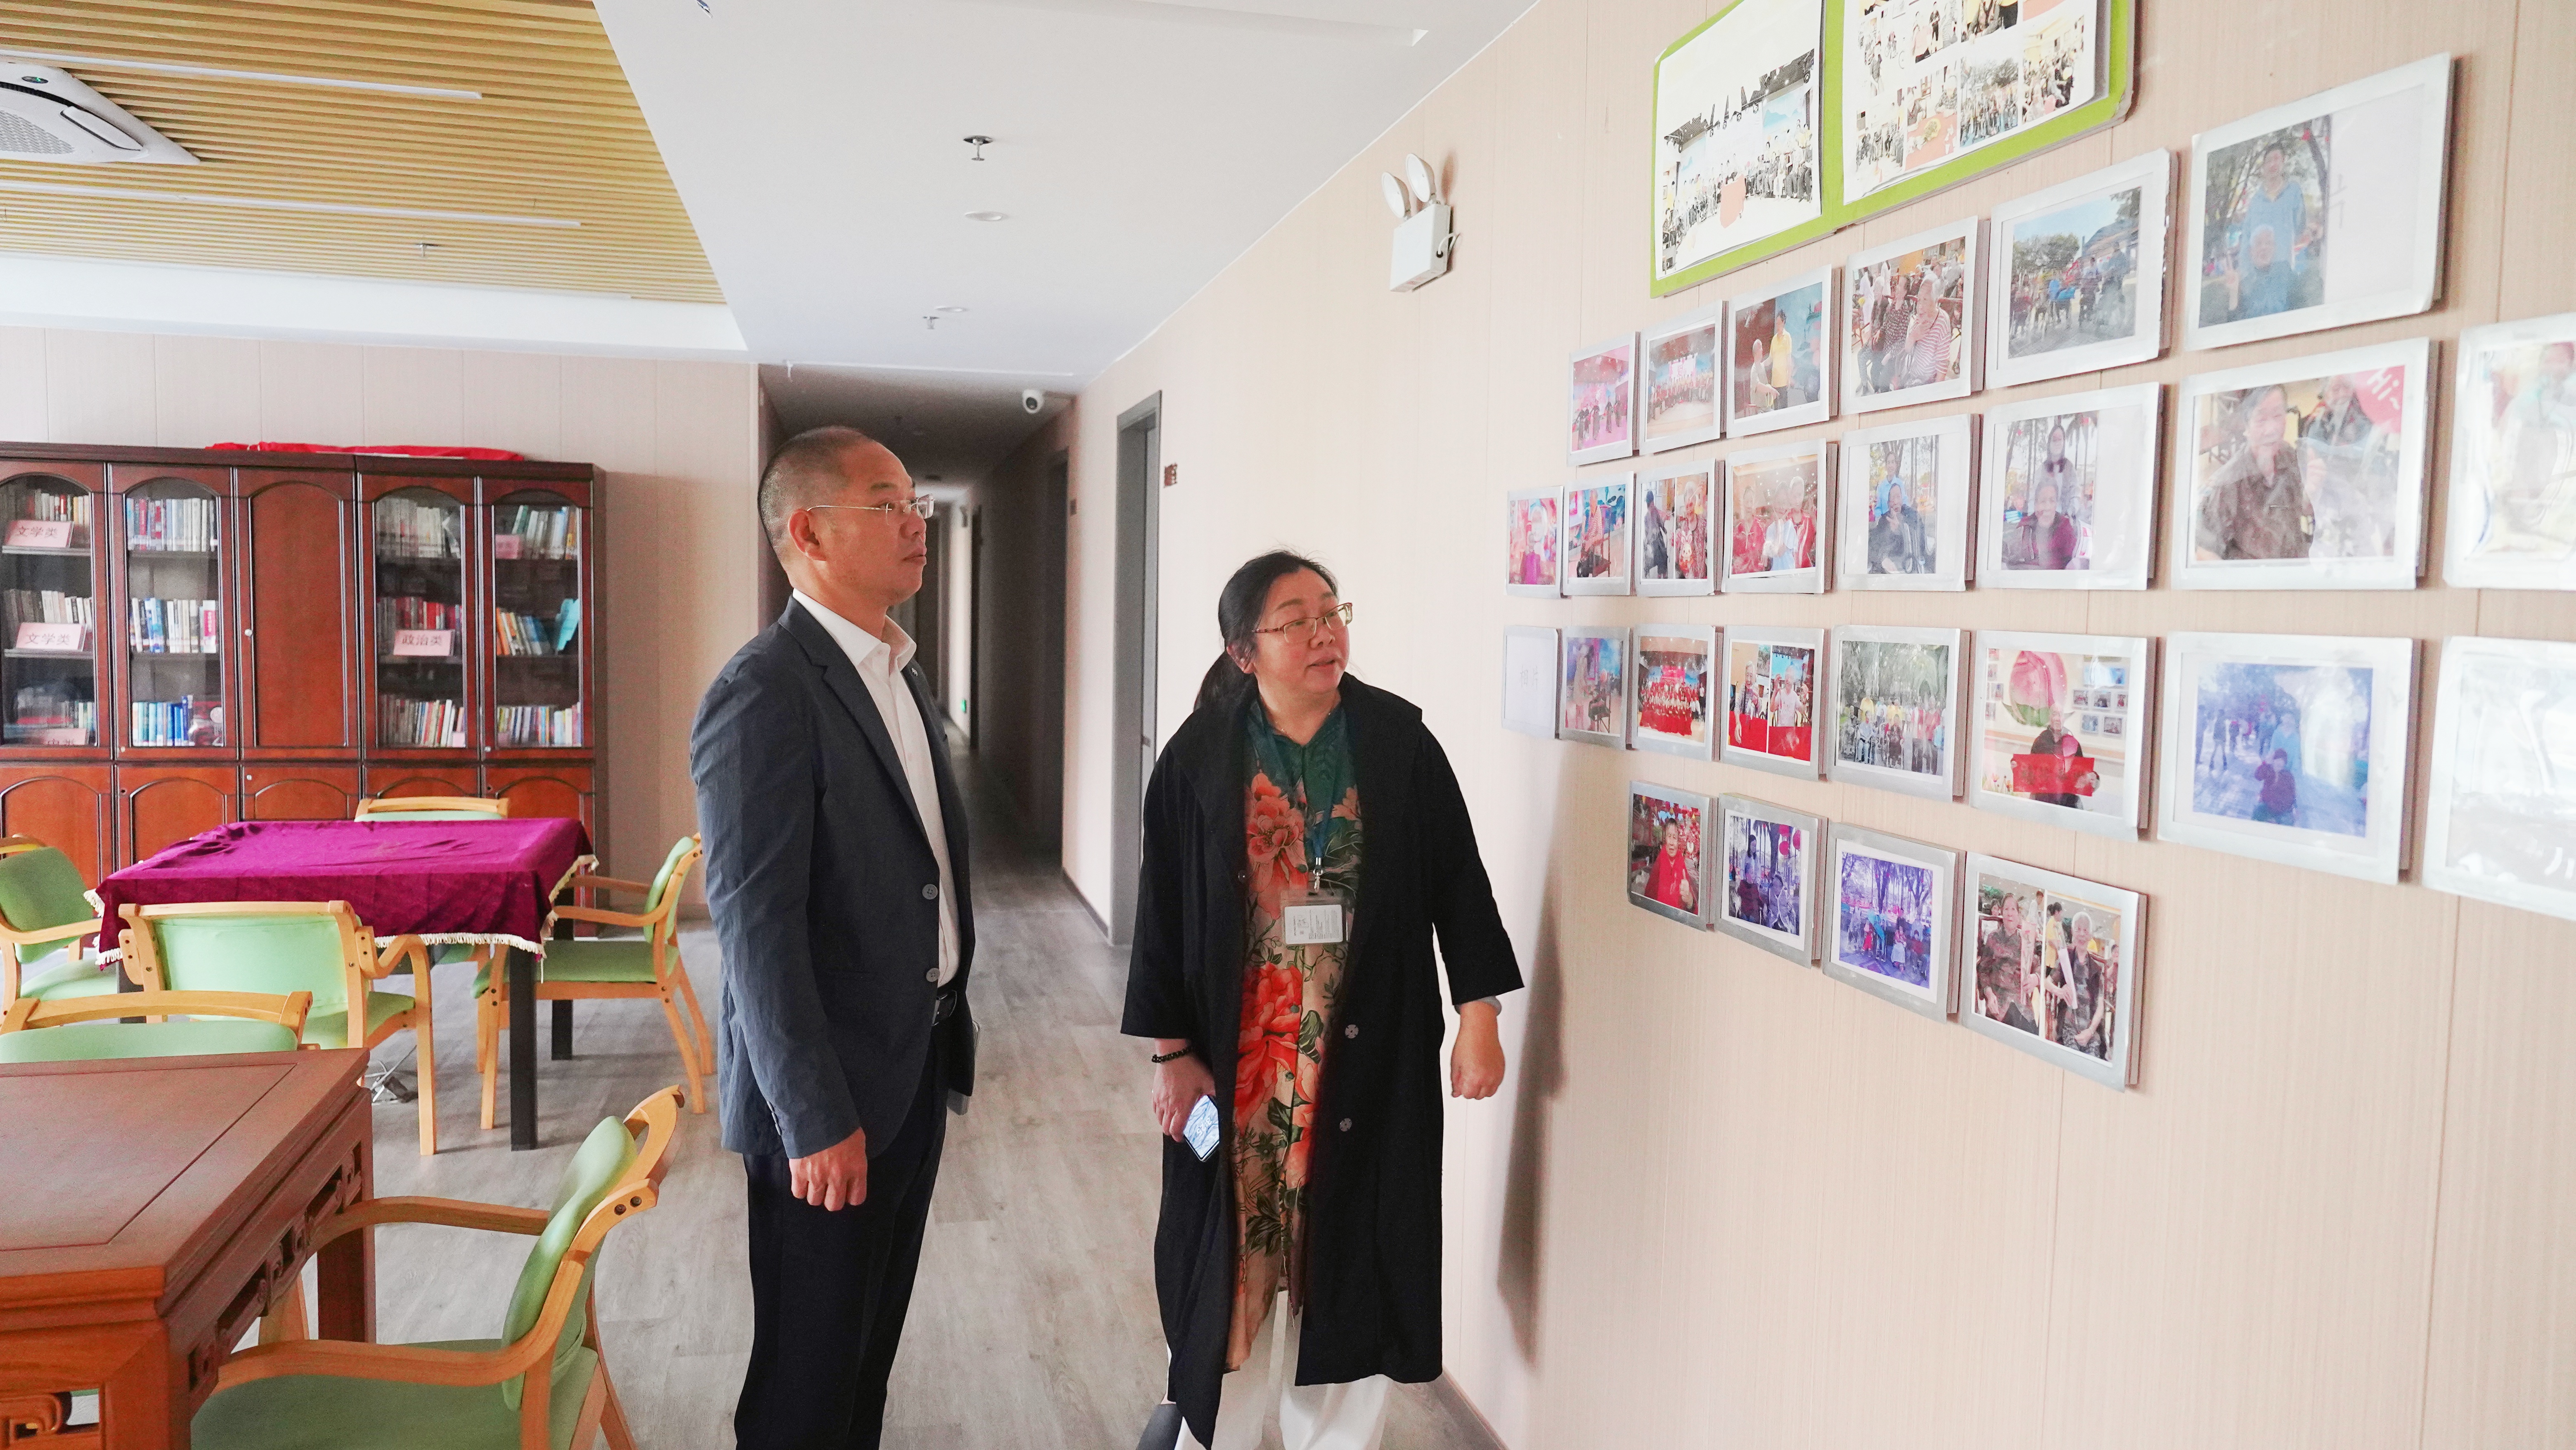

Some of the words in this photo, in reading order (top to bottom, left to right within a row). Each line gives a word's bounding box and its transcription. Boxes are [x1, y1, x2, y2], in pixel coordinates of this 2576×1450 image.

[18, 526, 57, 538] 文学类
[25, 633, 70, 645] 文学类
[402, 634, 442, 646] 政治类
